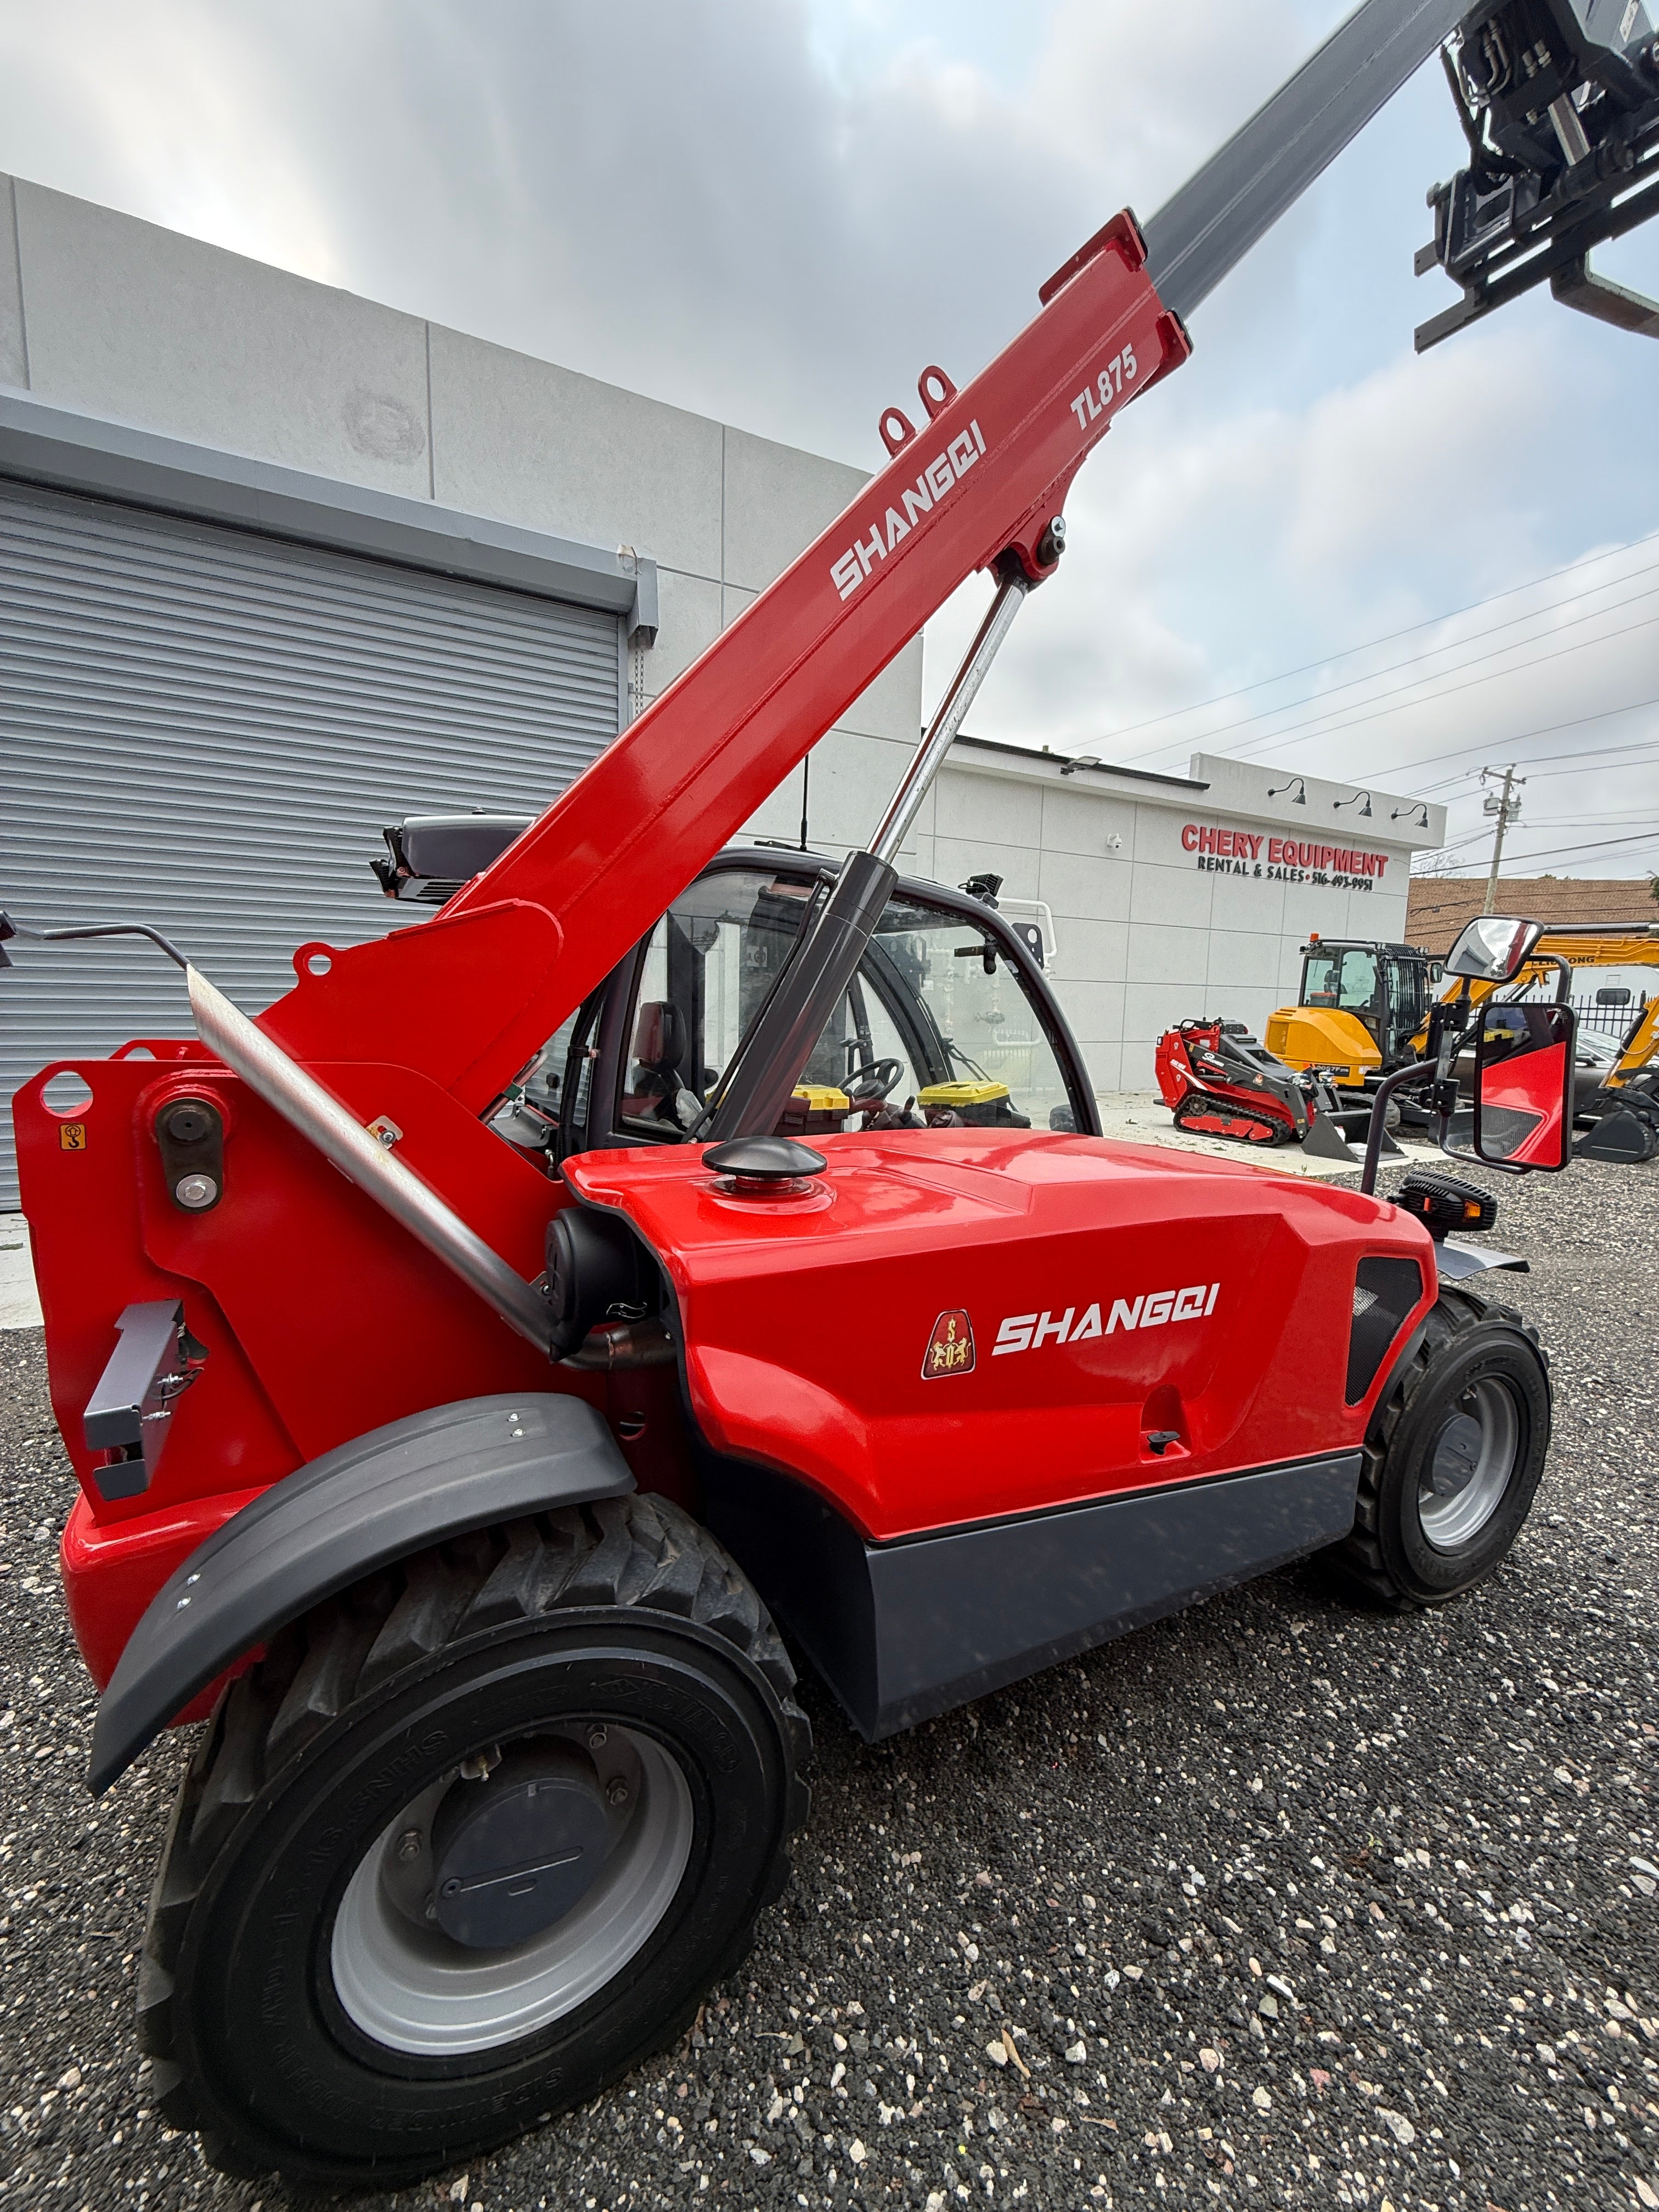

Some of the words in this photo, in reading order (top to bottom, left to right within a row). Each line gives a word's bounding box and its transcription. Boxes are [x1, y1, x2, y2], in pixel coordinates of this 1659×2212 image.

[1070, 343, 1138, 430] TL875
[830, 419, 986, 602] SHANGQI
[1181, 824, 1264, 859] CHERY
[1268, 838, 1389, 878] EQUIPMENT
[1198, 856, 1249, 876] RENTAL
[1254, 864, 1262, 878] &
[1267, 866, 1305, 882] SALES
[992, 1283, 1220, 1356] SHANGQI
